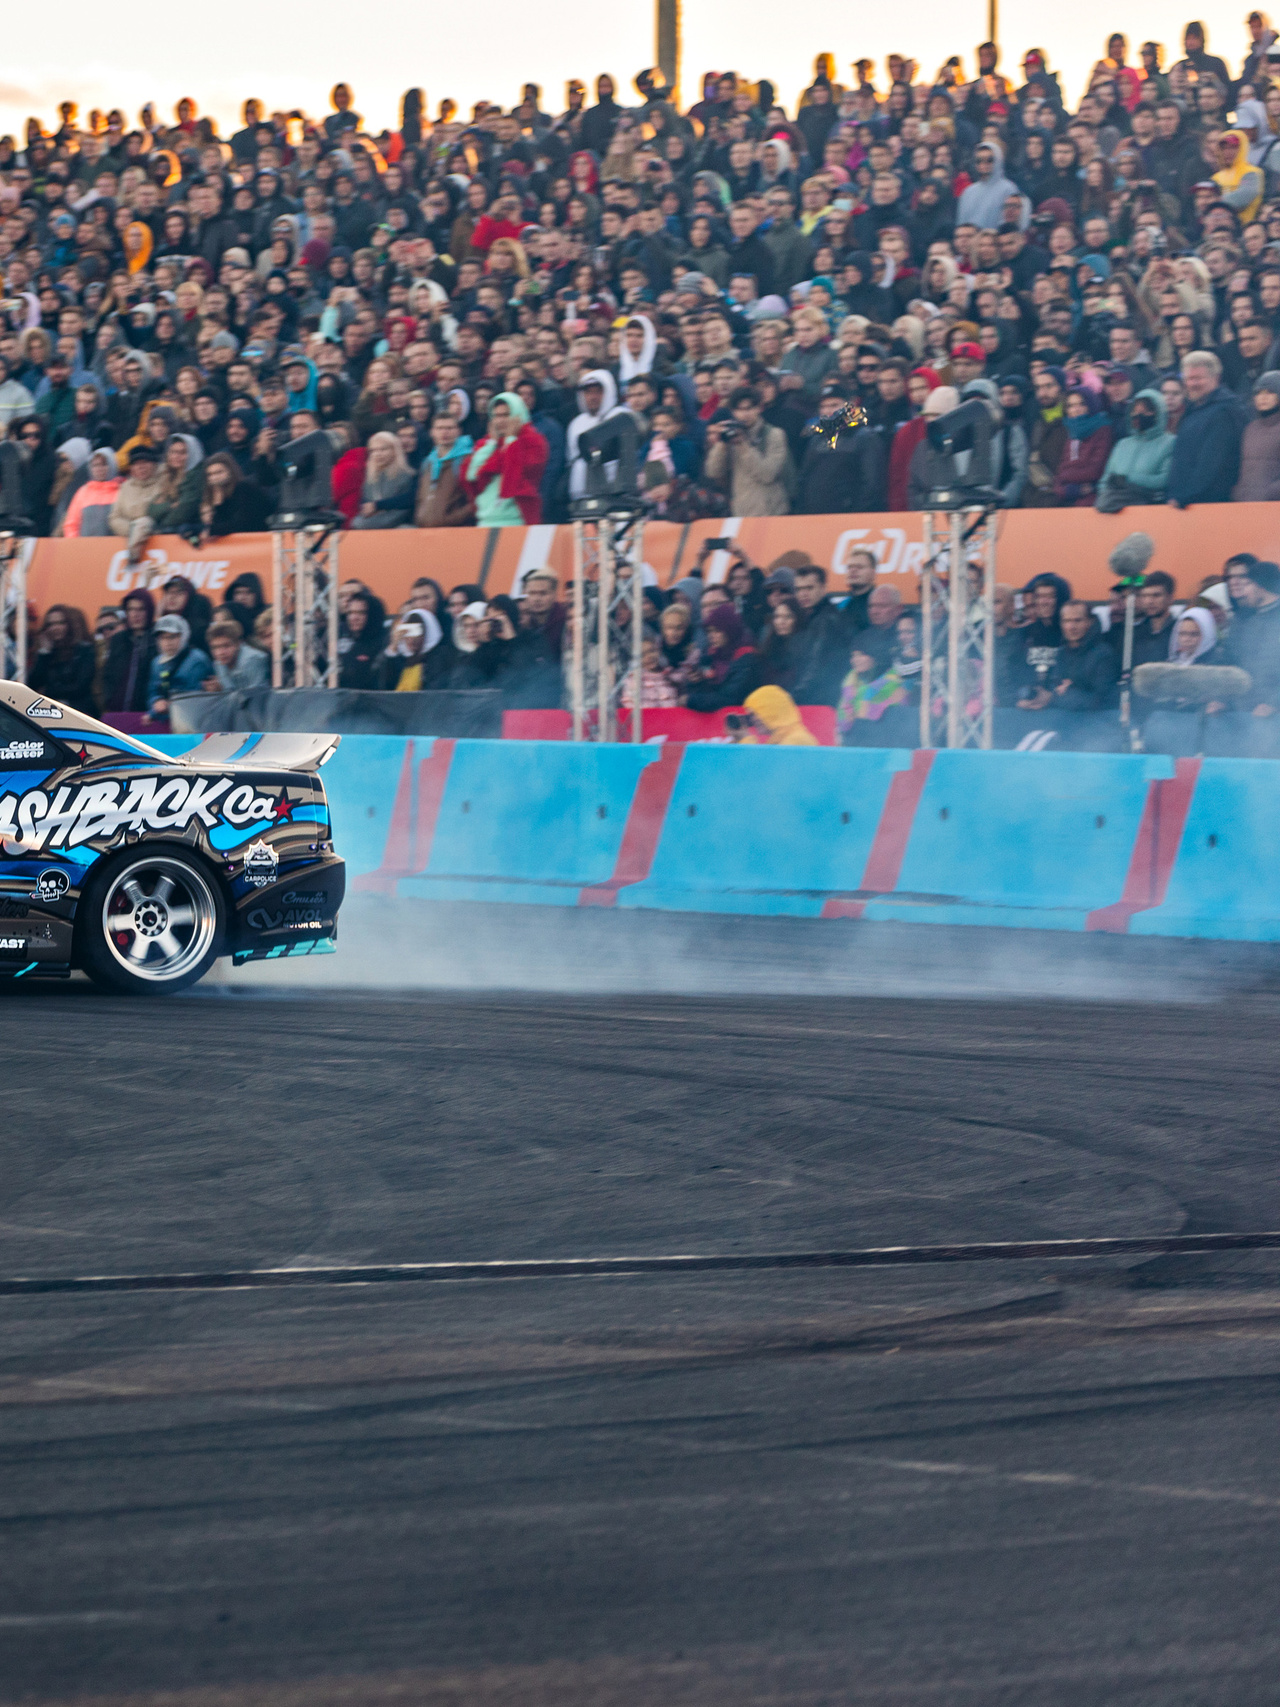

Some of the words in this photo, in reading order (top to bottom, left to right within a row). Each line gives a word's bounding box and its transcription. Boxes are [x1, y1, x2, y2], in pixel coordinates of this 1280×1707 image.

[9, 741, 44, 750] Color
[244, 875, 277, 883] CARPOLICE
[309, 921, 322, 929] OIL
